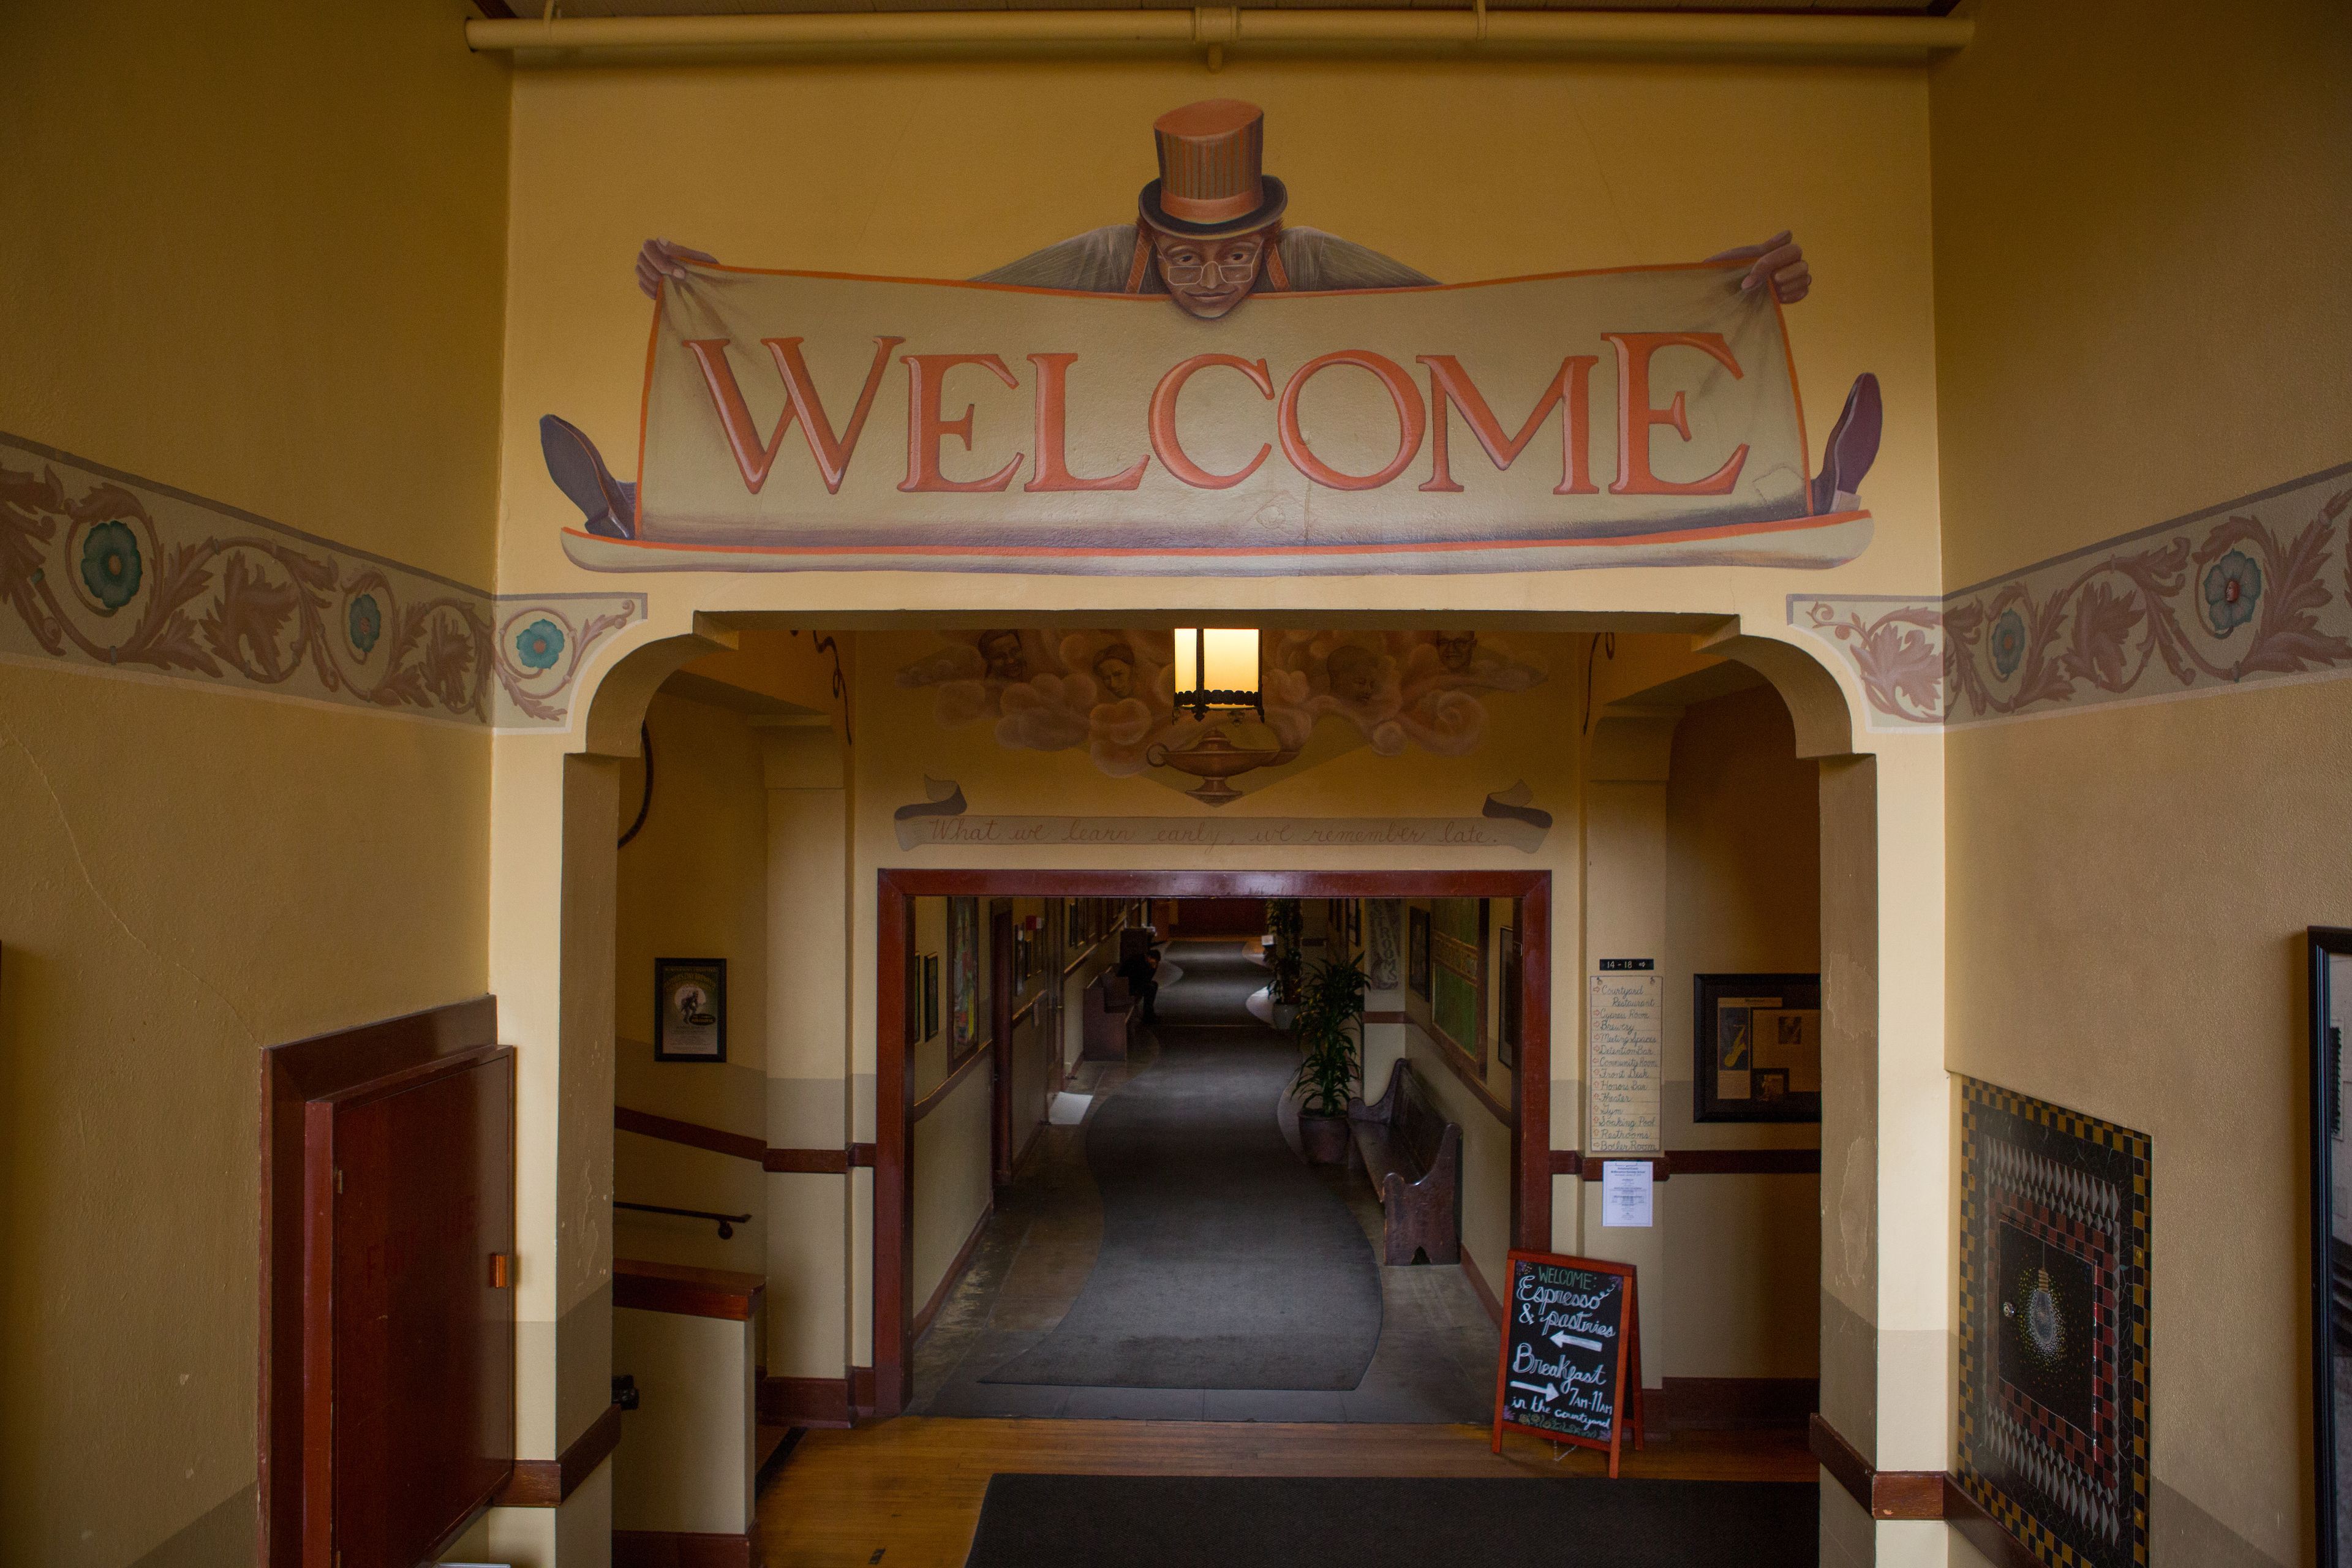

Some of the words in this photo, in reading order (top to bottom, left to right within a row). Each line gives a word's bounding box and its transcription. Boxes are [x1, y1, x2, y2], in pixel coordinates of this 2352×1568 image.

[683, 331, 1751, 496] WELCOME
[929, 818, 1001, 841] What
[1008, 824, 1049, 841] we
[1061, 819, 1133, 841] learn
[1250, 824, 1294, 841] we
[1302, 822, 1425, 843] remember
[1439, 823, 1498, 843] late.
[1601, 985, 1644, 1000] Courtyard
[1612, 997, 1655, 1007] Restaurant
[1600, 1008, 1627, 1020] Cypress
[1629, 1009, 1649, 1019] Room
[1600, 1020, 1634, 1035] Brewery
[1599, 1033, 1629, 1045] Meeting
[1630, 1032, 1656, 1047] Spaces
[1599, 1045, 1636, 1055] Detention
[1637, 1046, 1653, 1055] Bar
[1600, 1057, 1638, 1070] Community
[1639, 1057, 1657, 1066] Room
[1599, 1068, 1626, 1078] Front
[1627, 1068, 1650, 1078] Desk
[1601, 1080, 1629, 1090] Honors
[1631, 1080, 1647, 1090] Bar
[1599, 1093, 1633, 1102] Theater
[1598, 1117, 1636, 1131] Soaking
[1638, 1116, 1656, 1127] Pool
[1600, 1129, 1651, 1139] Restrooms
[1600, 1141, 1628, 1151] Boiler
[1629, 1140, 1657, 1151] Room
[1539, 1266, 1597, 1291] WELCOME:
[1517, 1276, 1604, 1315] Espresso
[1519, 1303, 1535, 1325] &
[1540, 1311, 1616, 1338] pastries
[1513, 1343, 1607, 1394] Breakfast
[1511, 1396, 1527, 1409] in
[1531, 1396, 1551, 1414] the
[1554, 1409, 1611, 1431] courtyard
